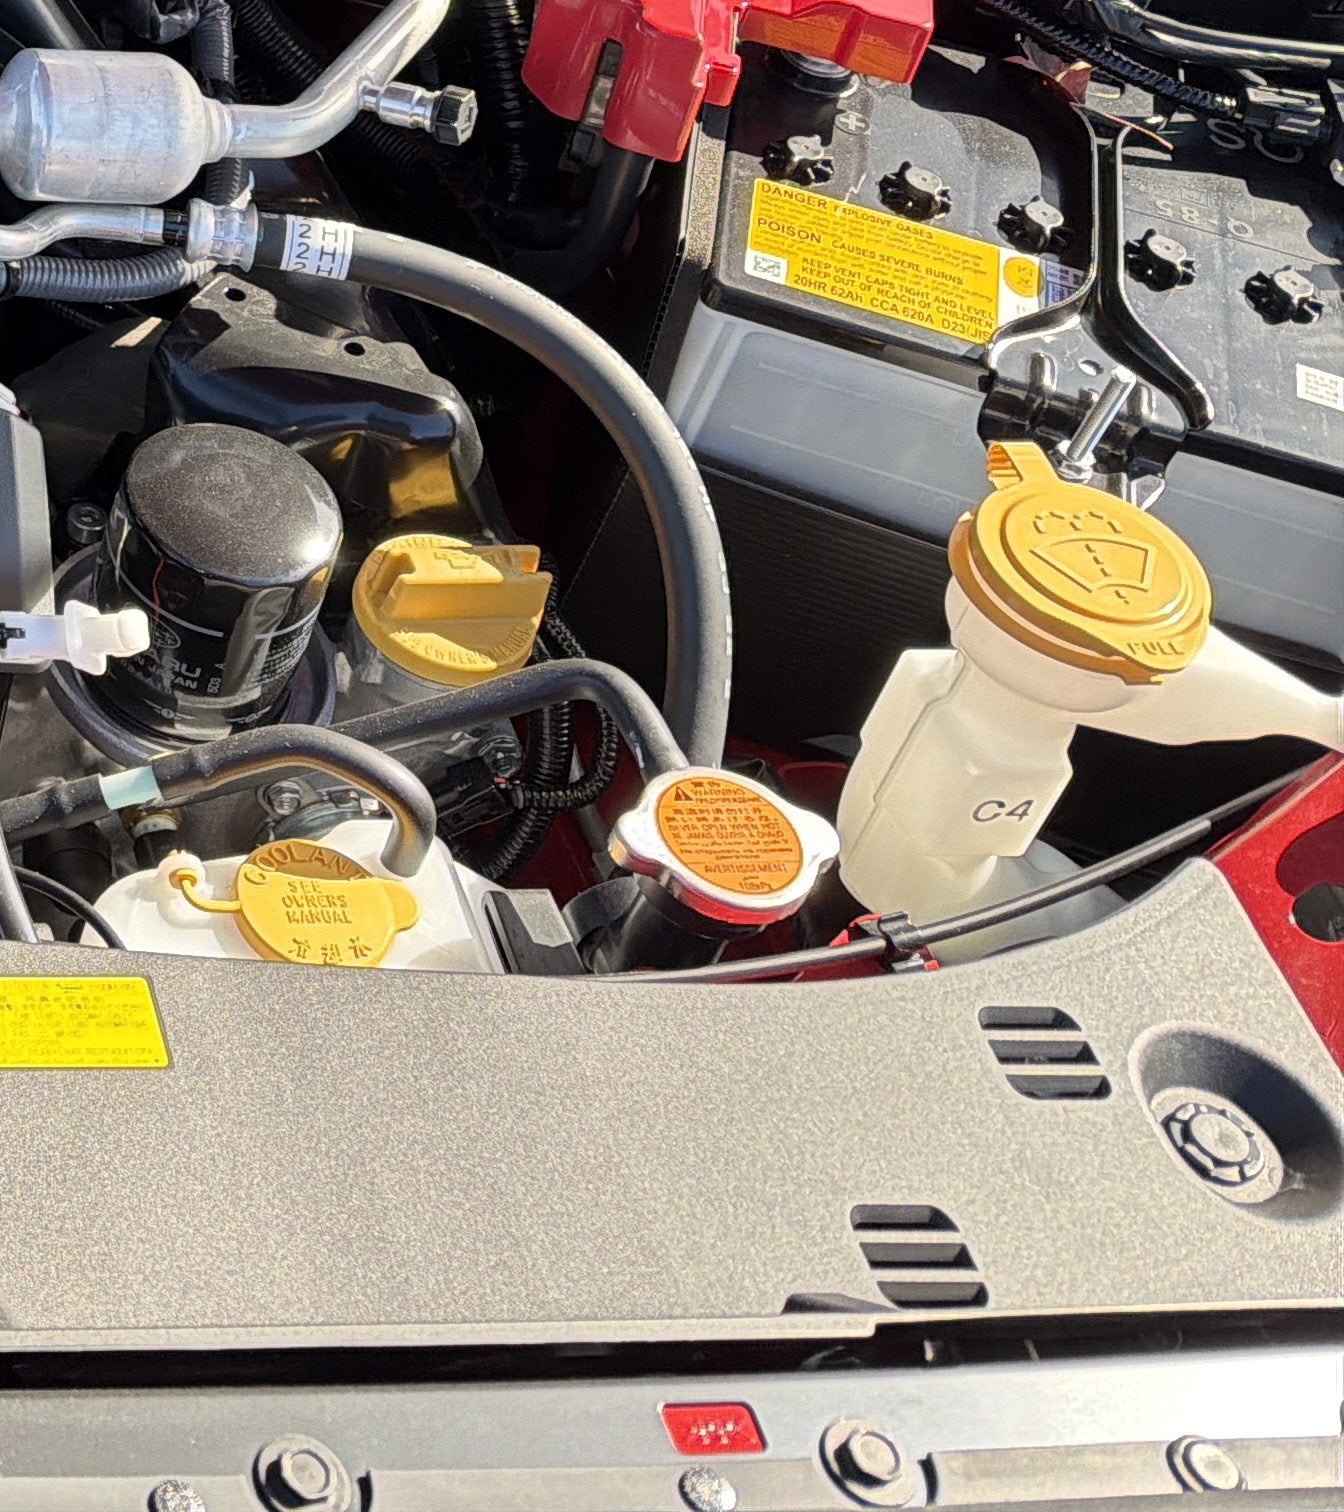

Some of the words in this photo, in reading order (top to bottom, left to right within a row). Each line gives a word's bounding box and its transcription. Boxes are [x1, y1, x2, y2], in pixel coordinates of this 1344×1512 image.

[761, 182, 828, 210] DANGER
[757, 217, 823, 244] POISON
[879, 253, 922, 273] SEVERE
[925, 267, 964, 286] BURNS
[793, 273, 828, 294] 20HR
[830, 284, 864, 304] 62Ah
[870, 297, 899, 316] CCA
[902, 305, 935, 325] 620A
[833, 274, 857, 290] OUT
[877, 286, 916, 307] REACH
[935, 305, 994, 330] CHILDREN
[834, 265, 863, 280] VENT
[899, 282, 931, 301] TIGHT
[934, 293, 957, 309] AND
[959, 301, 995, 321] LEVEL
[972, 799, 1034, 822] C4
[287, 880, 322, 894] SEE
